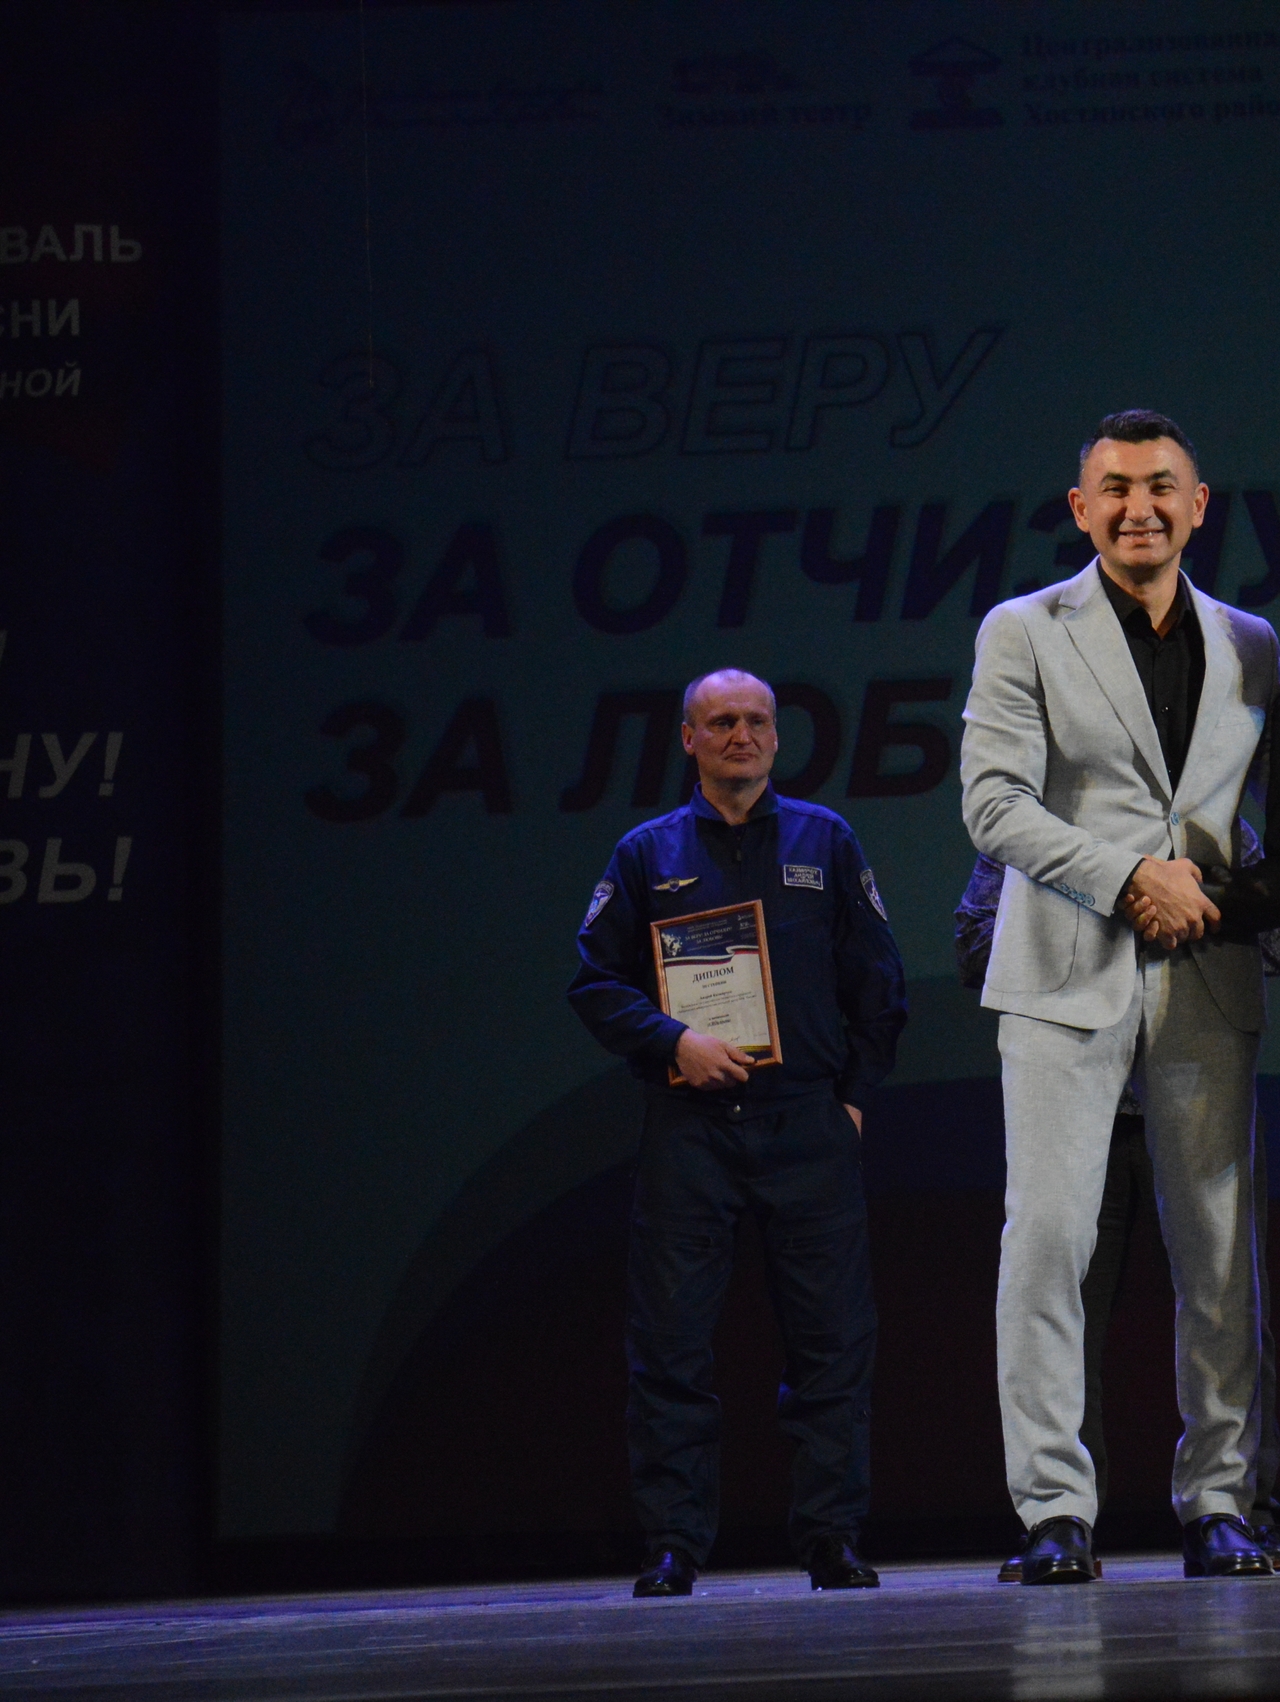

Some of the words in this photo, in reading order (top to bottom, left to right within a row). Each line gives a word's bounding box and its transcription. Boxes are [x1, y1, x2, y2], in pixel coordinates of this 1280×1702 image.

[0, 223, 143, 264] ВАЛЬ
[0, 297, 81, 339] НИ
[302, 344, 514, 471] ЗА
[565, 323, 1006, 463] ВЕРУ
[302, 513, 515, 647] ЗА
[302, 695, 515, 824] ЗА
[692, 966, 734, 983] ДИПЛОМ
